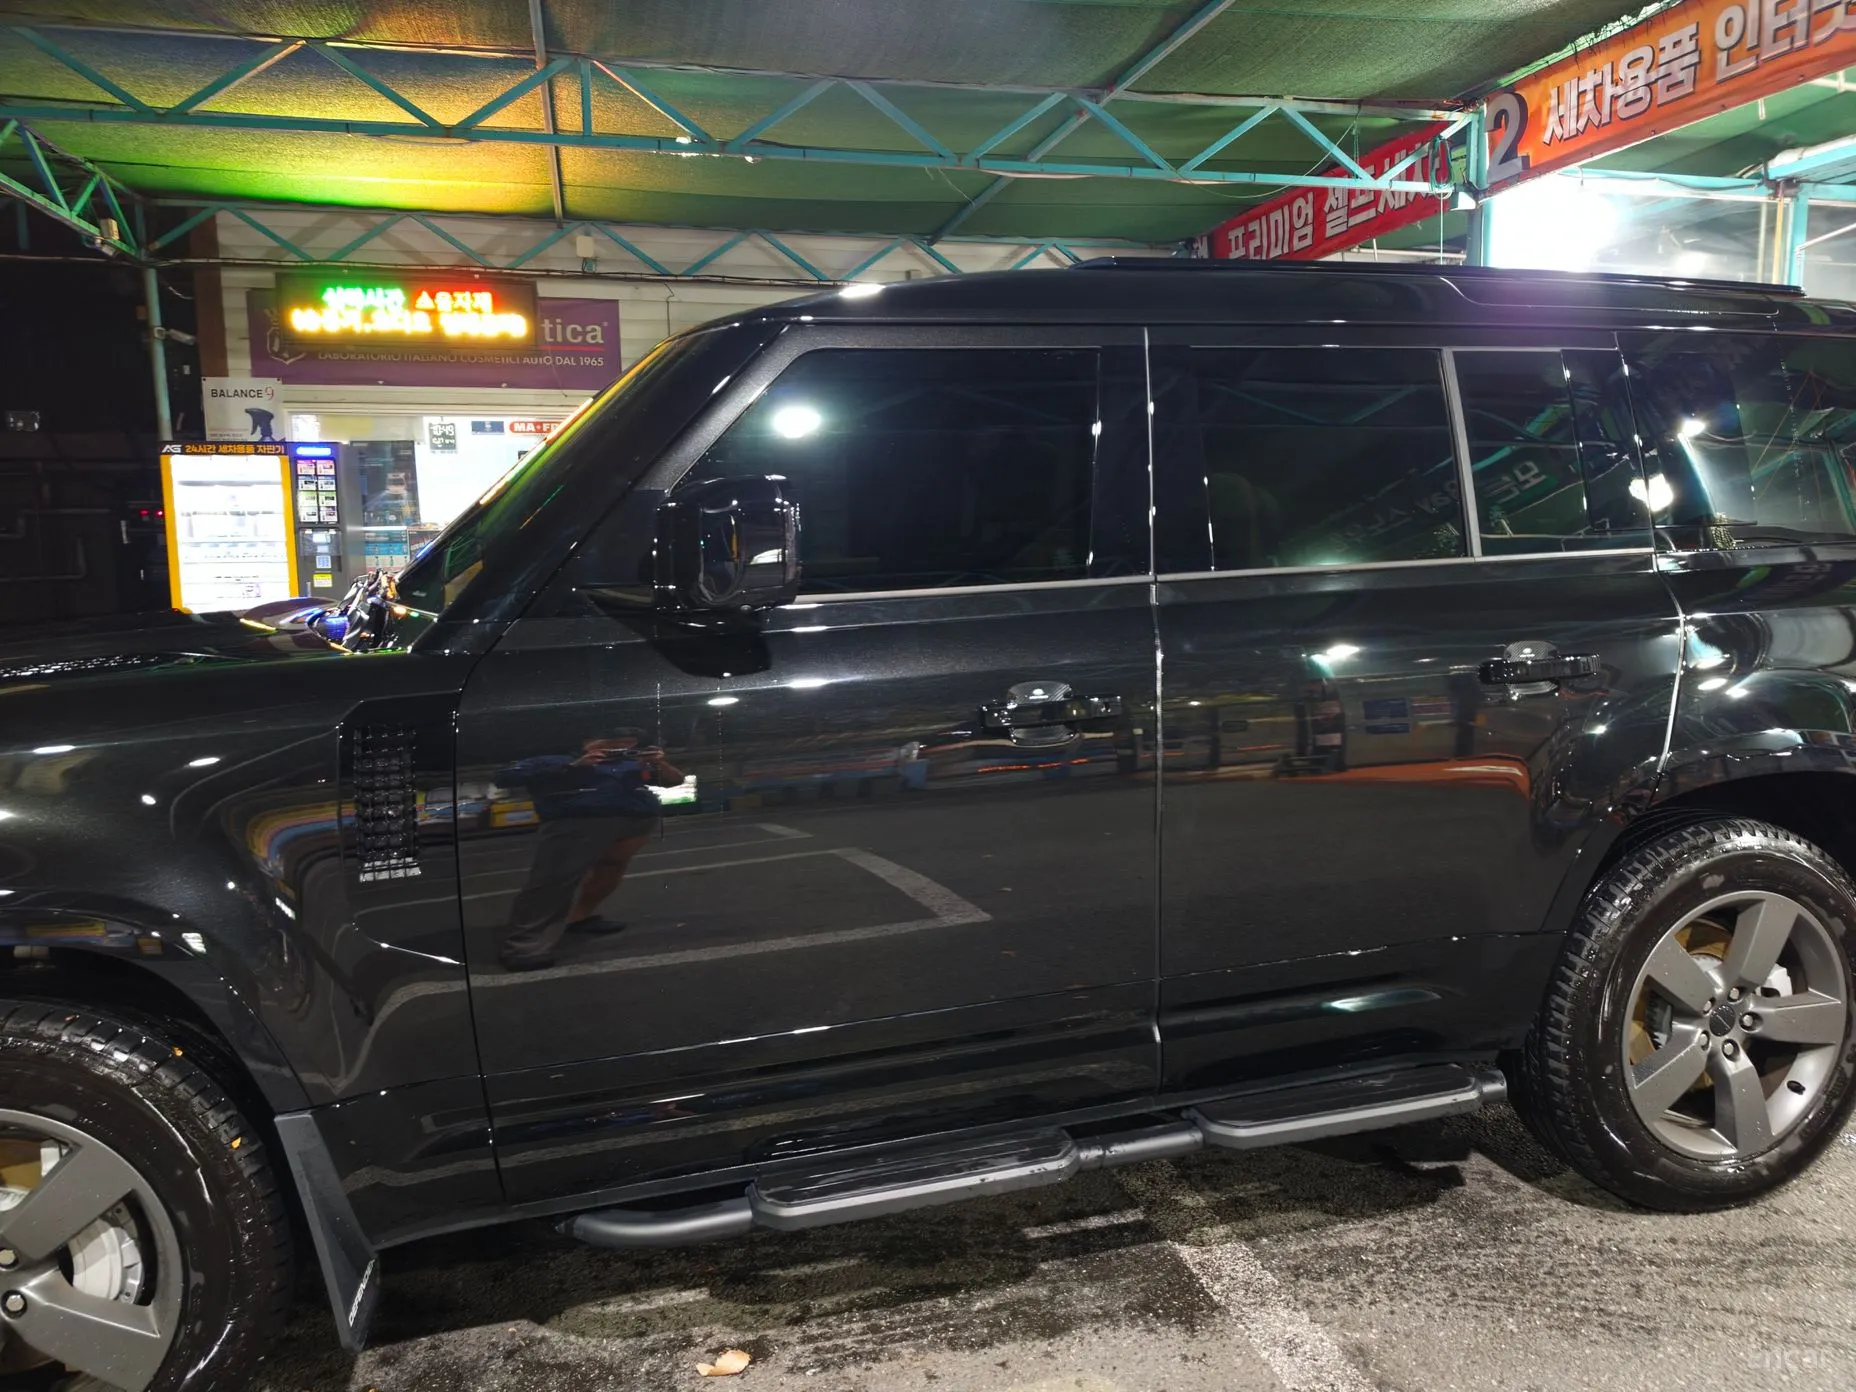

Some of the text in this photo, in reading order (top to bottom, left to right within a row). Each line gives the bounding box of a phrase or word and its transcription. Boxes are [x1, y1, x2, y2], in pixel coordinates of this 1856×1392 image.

[1543, 21, 1701, 145] 세차용품
[1227, 191, 1314, 259] 프리미엄
[555, 356, 577, 366] DAL
[579, 356, 604, 367] 1965
[185, 444, 216, 454] 24시간
